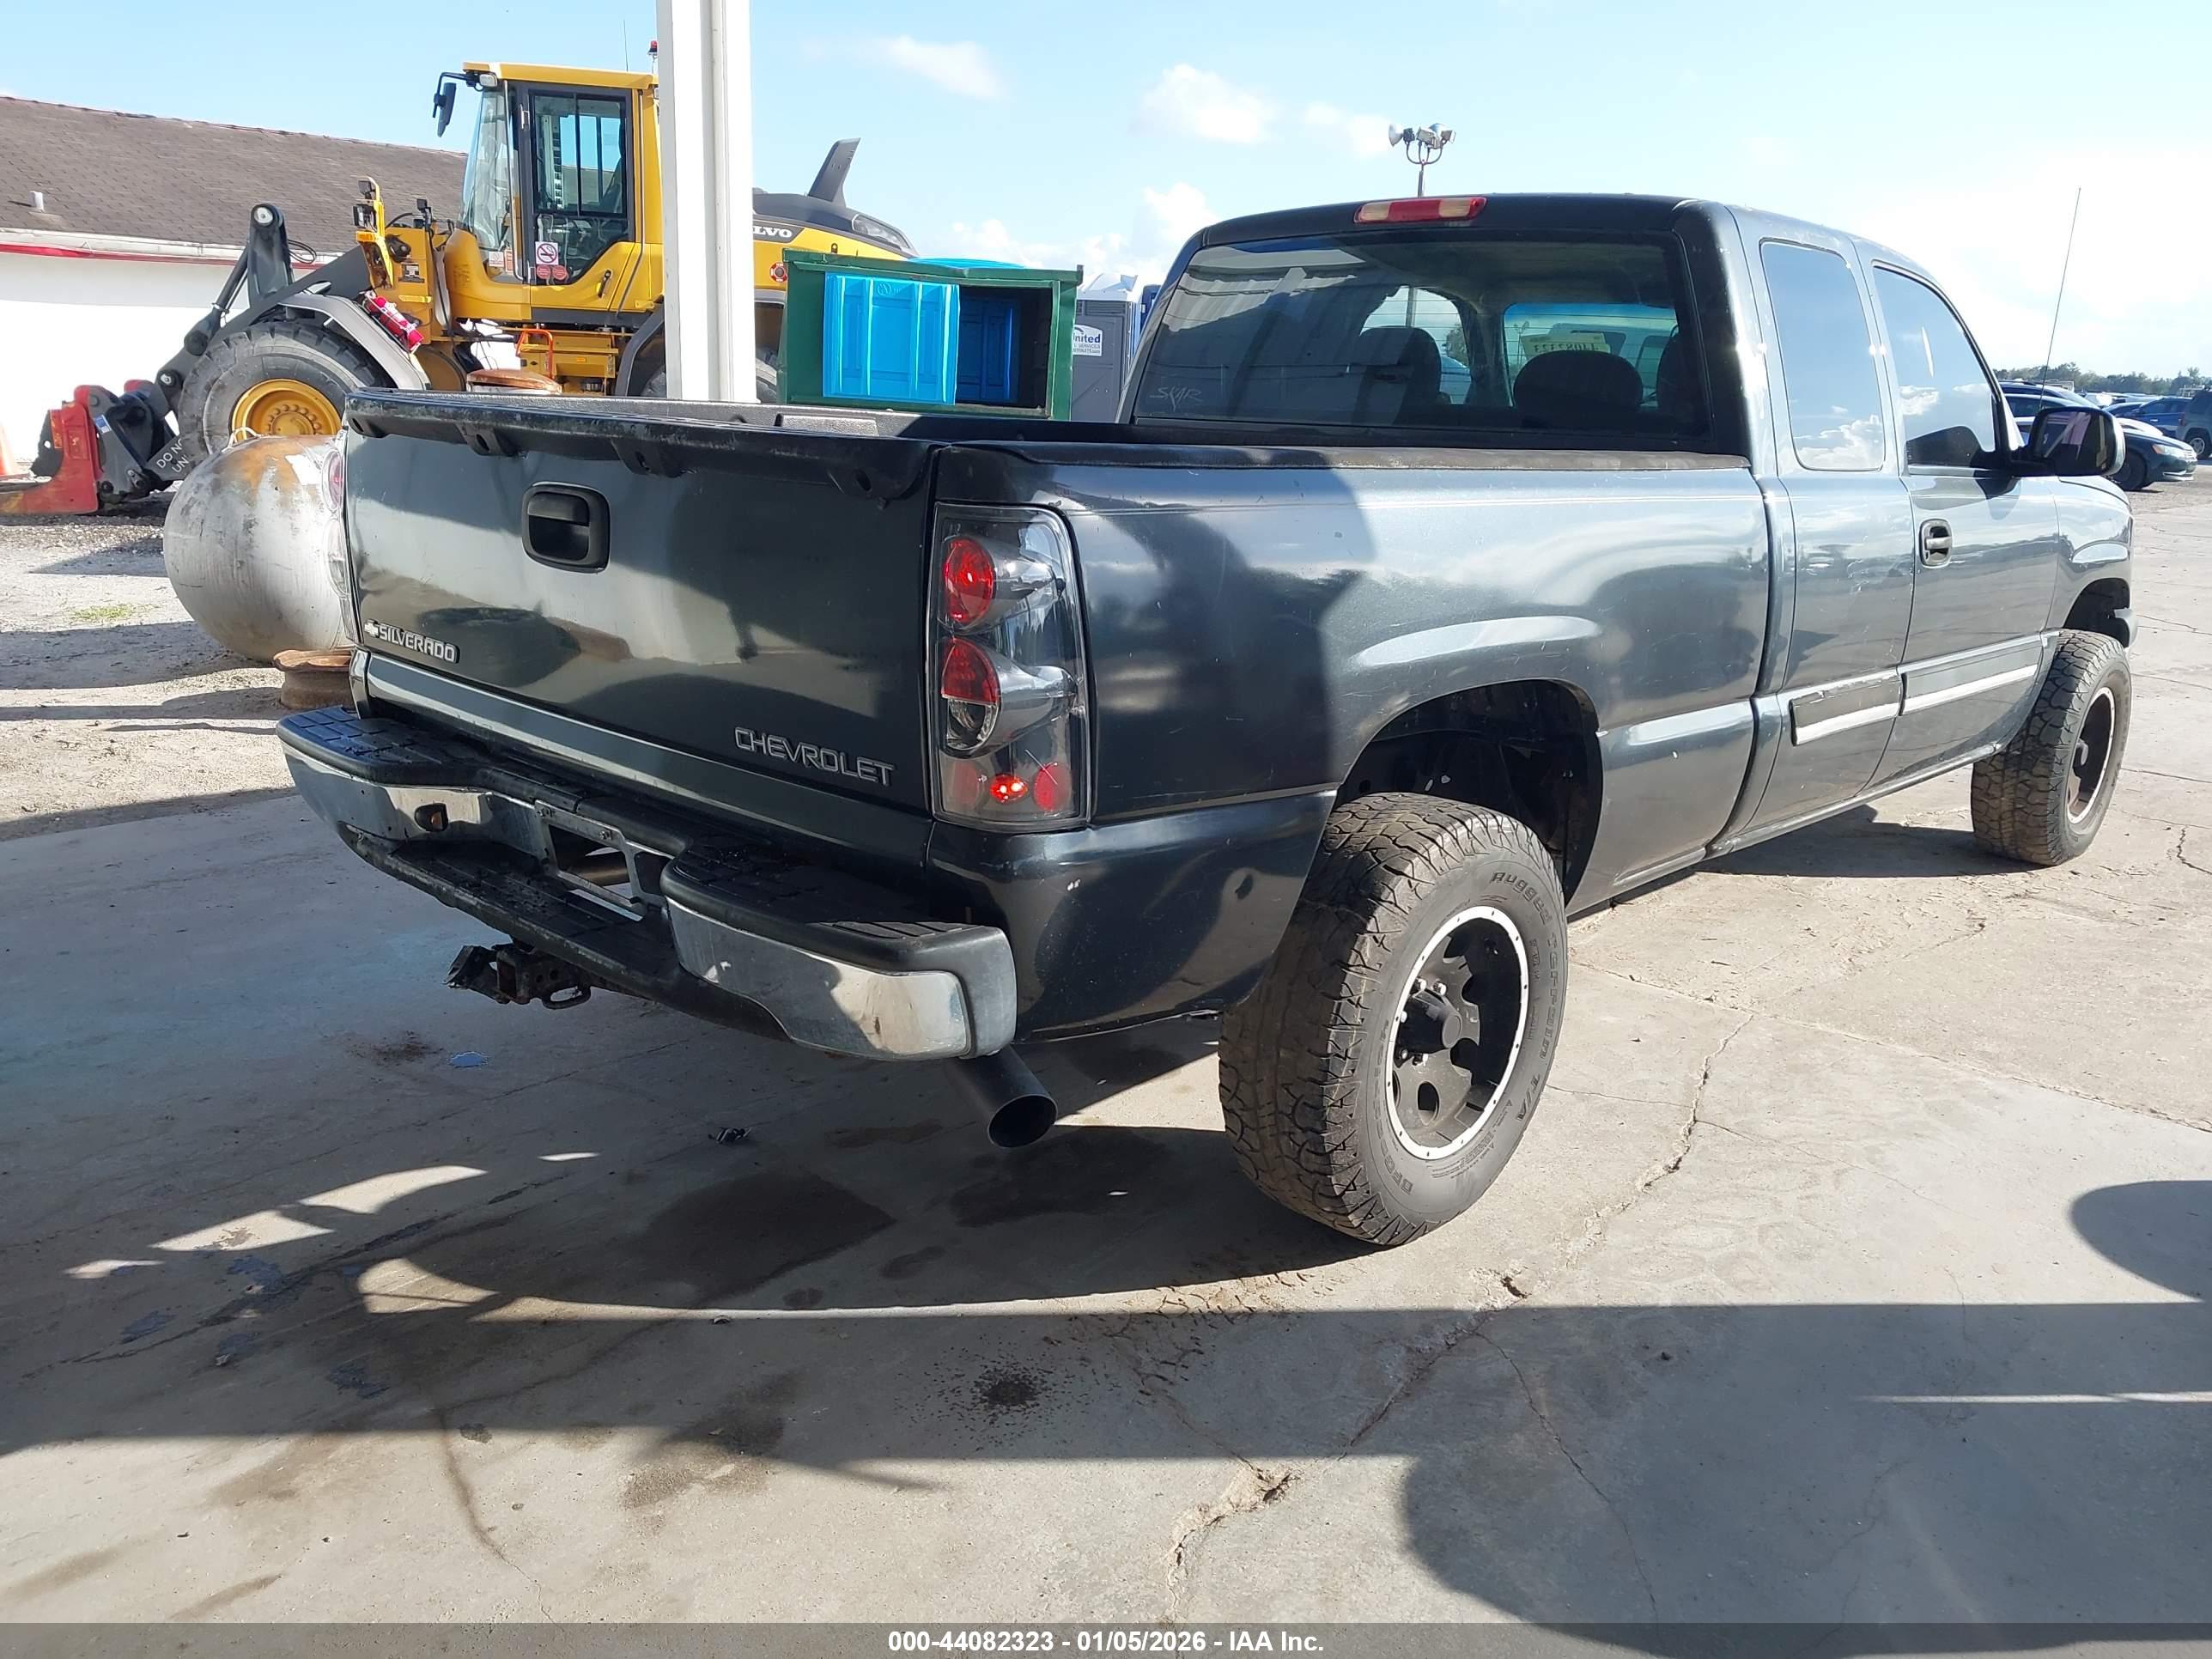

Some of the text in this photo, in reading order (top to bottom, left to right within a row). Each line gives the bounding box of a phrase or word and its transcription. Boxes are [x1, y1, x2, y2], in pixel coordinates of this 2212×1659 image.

[753, 225, 792, 238] LVO
[1073, 332, 1101, 343] nited
[156, 453, 173, 468] DO
[172, 454, 189, 472] UN
[379, 623, 458, 663] SILVERADO
[735, 727, 895, 787] CHEVROLET
